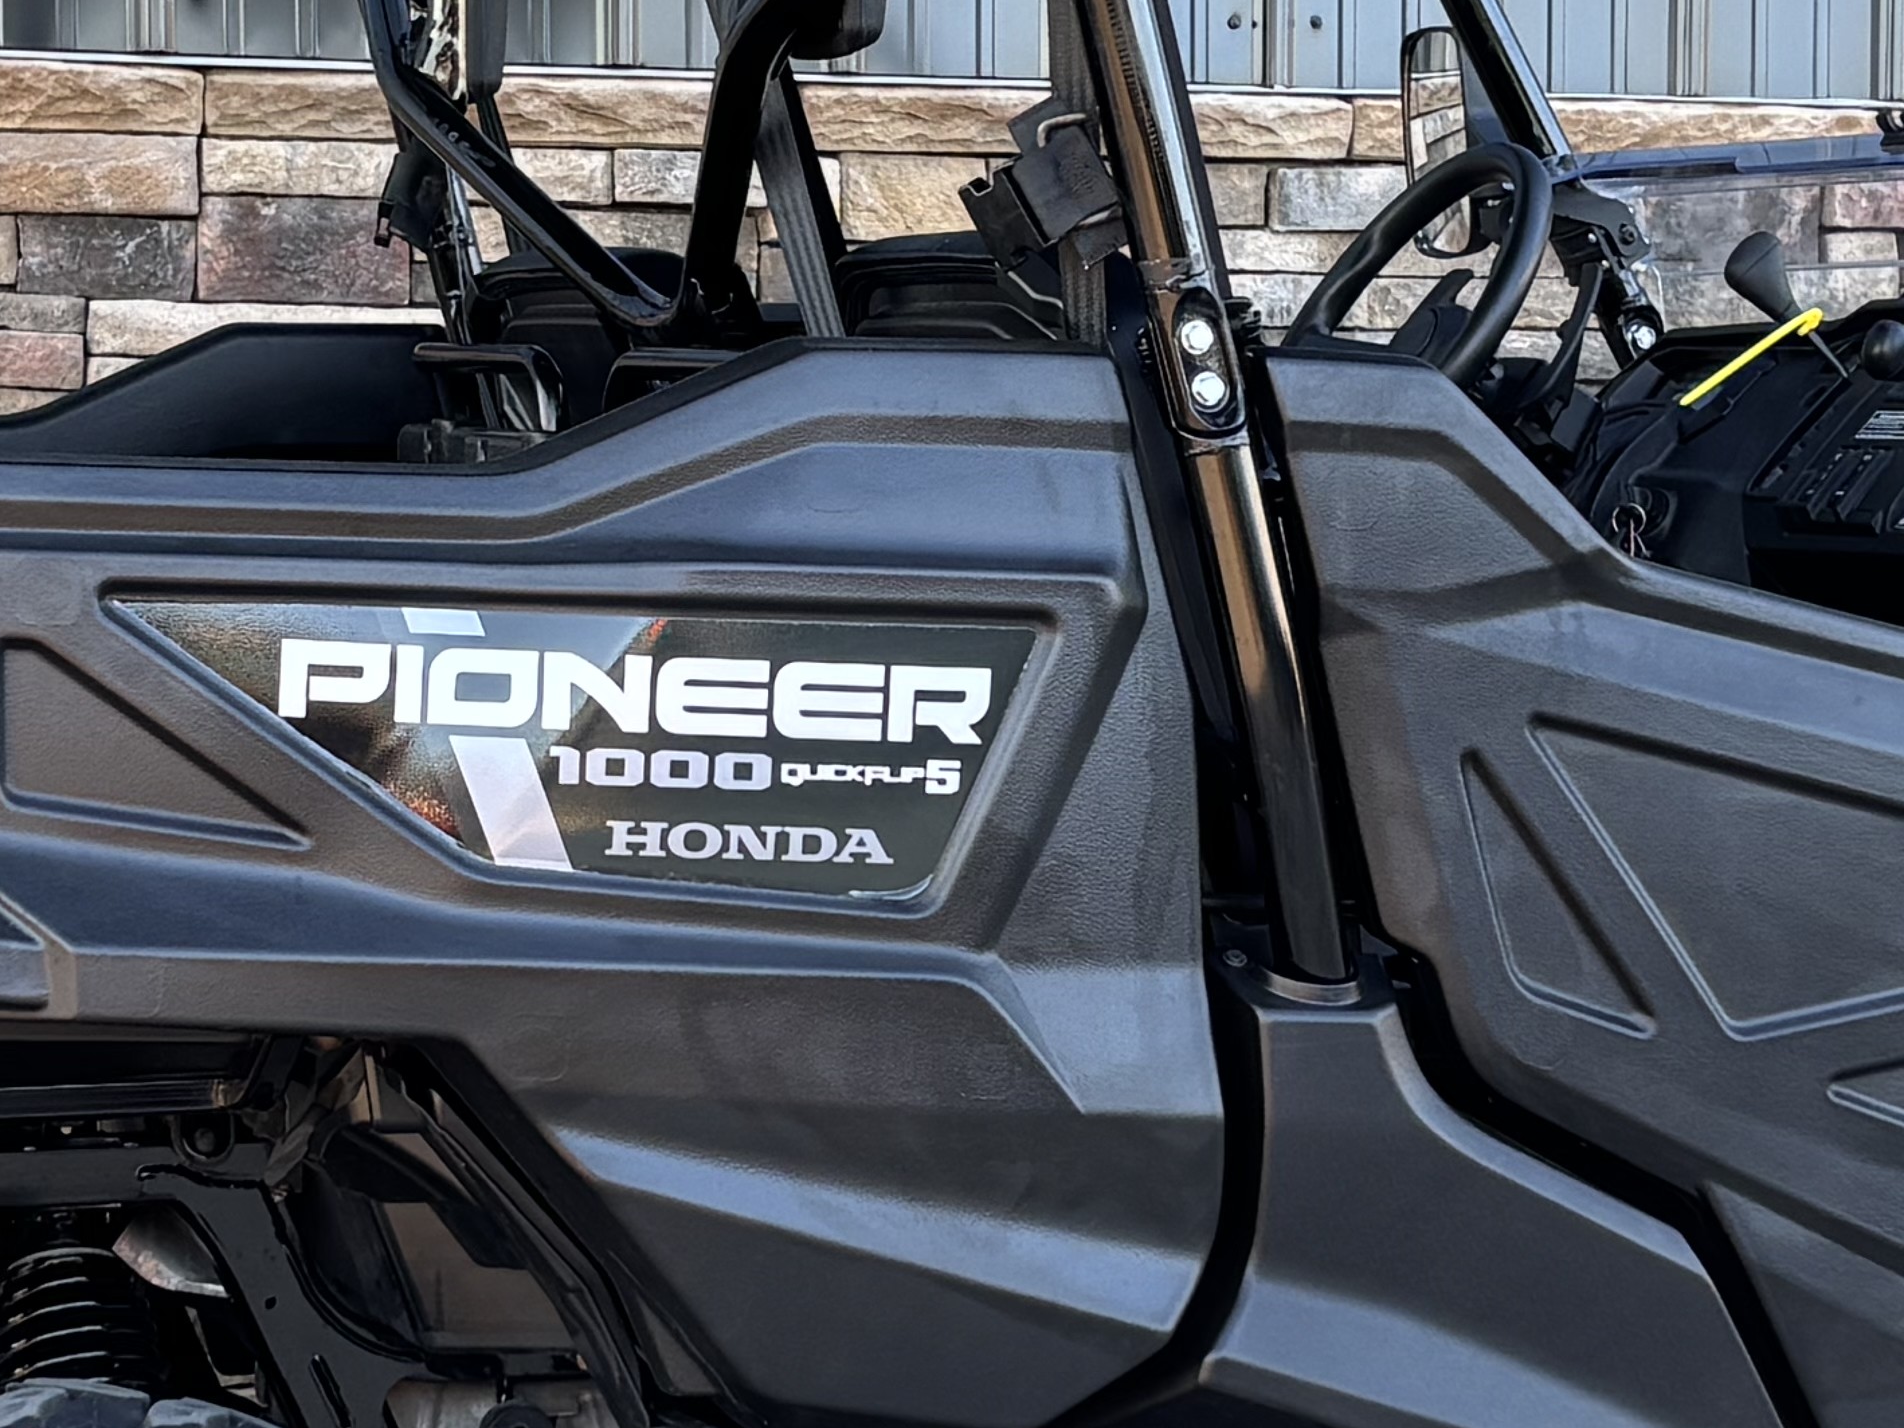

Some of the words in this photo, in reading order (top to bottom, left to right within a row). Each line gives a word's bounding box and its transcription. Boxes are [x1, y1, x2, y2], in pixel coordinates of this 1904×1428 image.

[278, 637, 992, 745] PIONEER
[549, 745, 773, 791] 1000
[604, 819, 894, 865] HONDA
